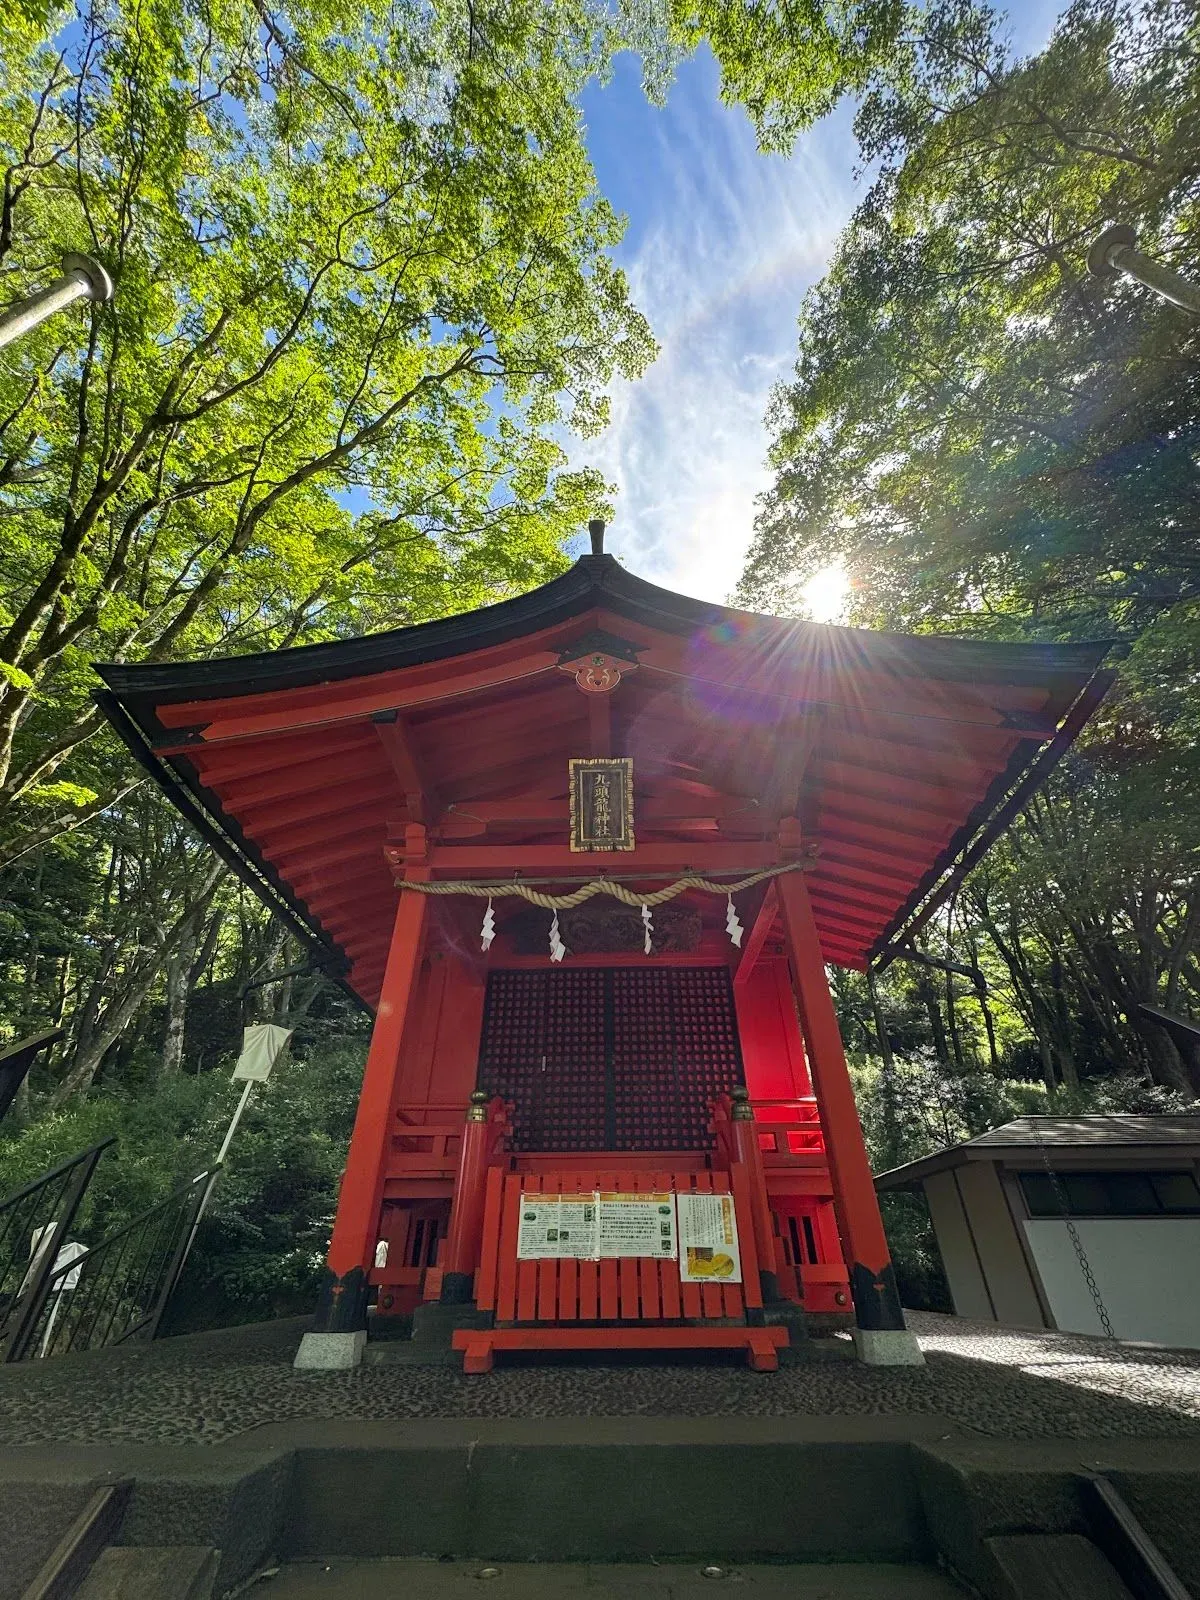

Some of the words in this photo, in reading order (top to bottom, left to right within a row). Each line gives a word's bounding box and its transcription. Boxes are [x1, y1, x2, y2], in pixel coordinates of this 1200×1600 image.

[594, 773, 612, 838] 九頭龍神社
